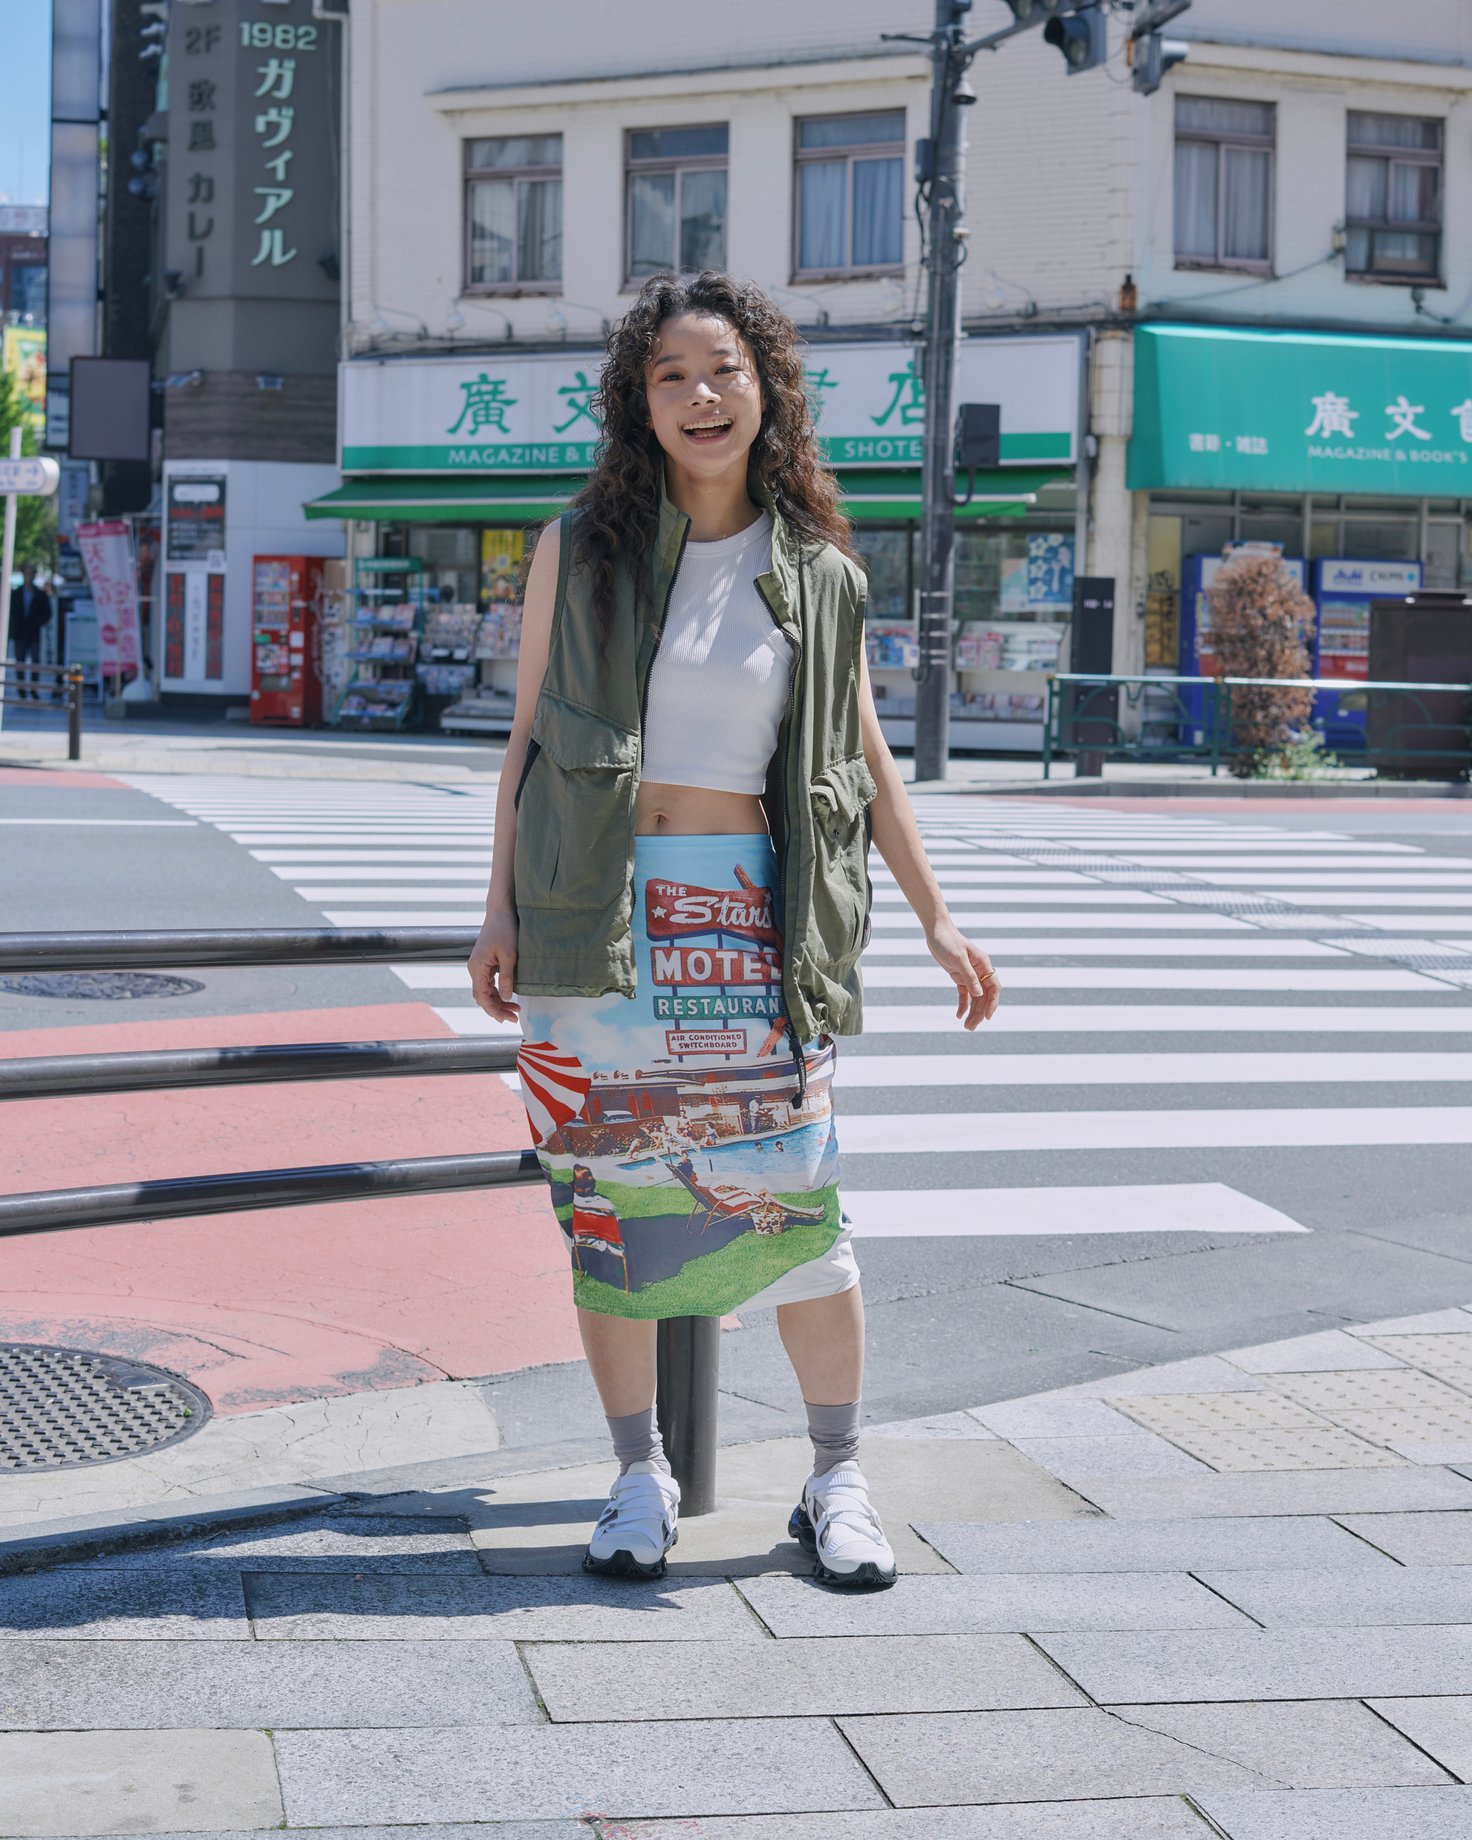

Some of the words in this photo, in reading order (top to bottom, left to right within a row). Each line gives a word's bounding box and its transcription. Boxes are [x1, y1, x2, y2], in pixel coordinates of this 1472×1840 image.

[185, 25, 222, 56] 2F
[240, 22, 317, 50] 1982
[251, 58, 297, 267] ガヴィアル
[448, 448, 560, 465] MAGAZINE
[565, 446, 580, 463] &
[844, 440, 924, 458] SHOTE
[1307, 446, 1391, 461] MAGAZINE
[1395, 449, 1408, 462] &
[656, 884, 687, 897] THE
[655, 950, 782, 981] MOTEL
[658, 998, 780, 1015] RESTAURAN
[678, 1041, 737, 1049] SWITCHBOARD
[688, 1033, 742, 1041] CONDITIONED
